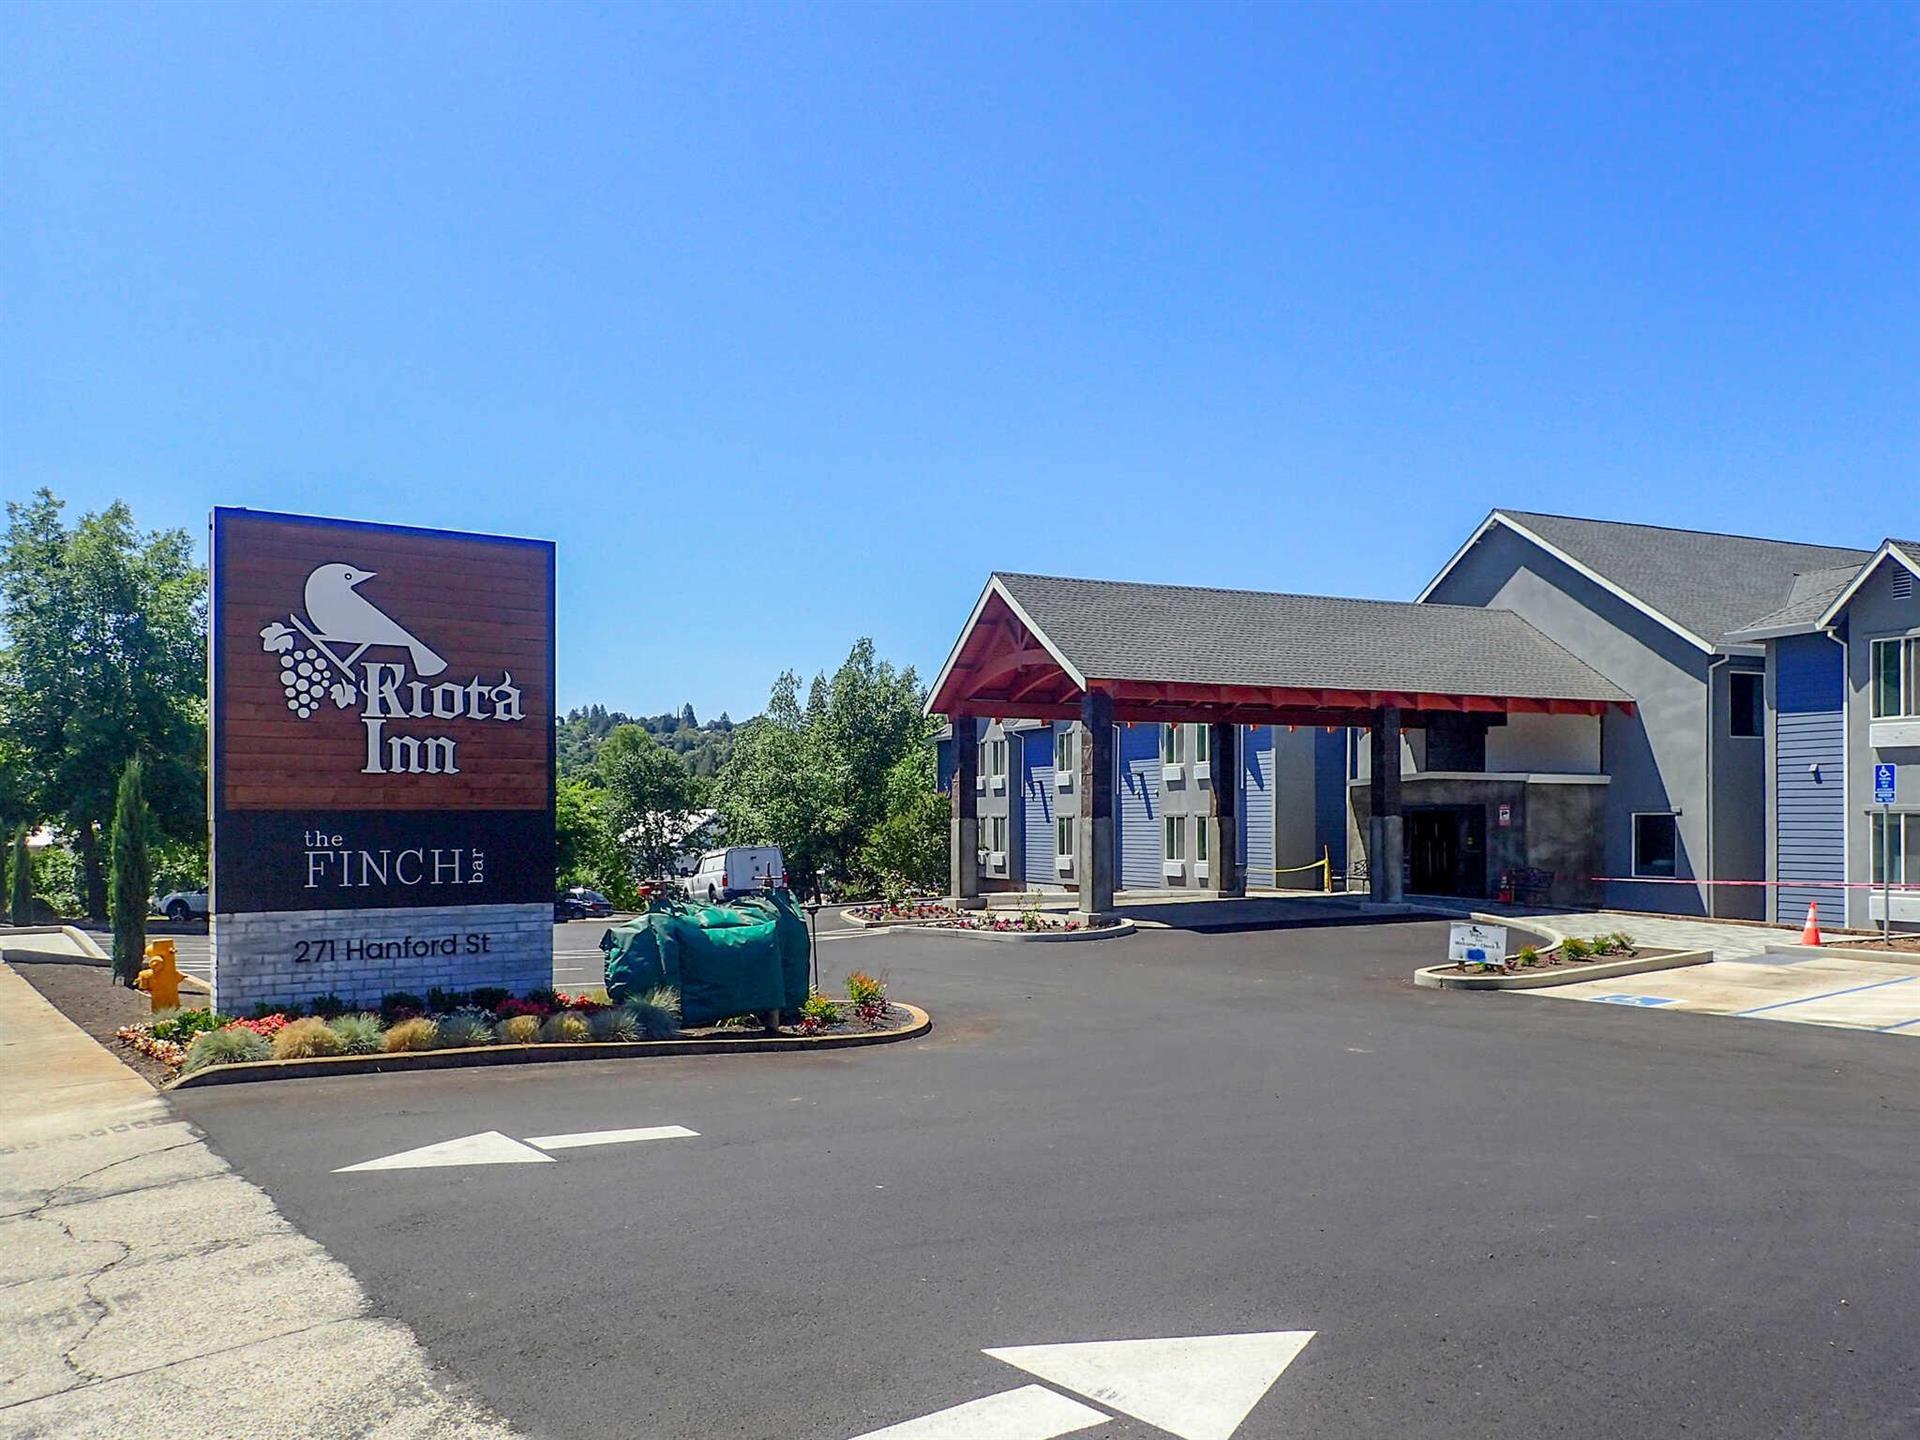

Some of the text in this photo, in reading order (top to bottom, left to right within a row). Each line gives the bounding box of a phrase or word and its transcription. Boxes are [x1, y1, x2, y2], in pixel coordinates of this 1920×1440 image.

[361, 718, 460, 774] Inn
[304, 830, 344, 847] the
[303, 848, 464, 888] FINCH
[468, 848, 485, 884] bar
[295, 933, 491, 963] 271 Hanford St
